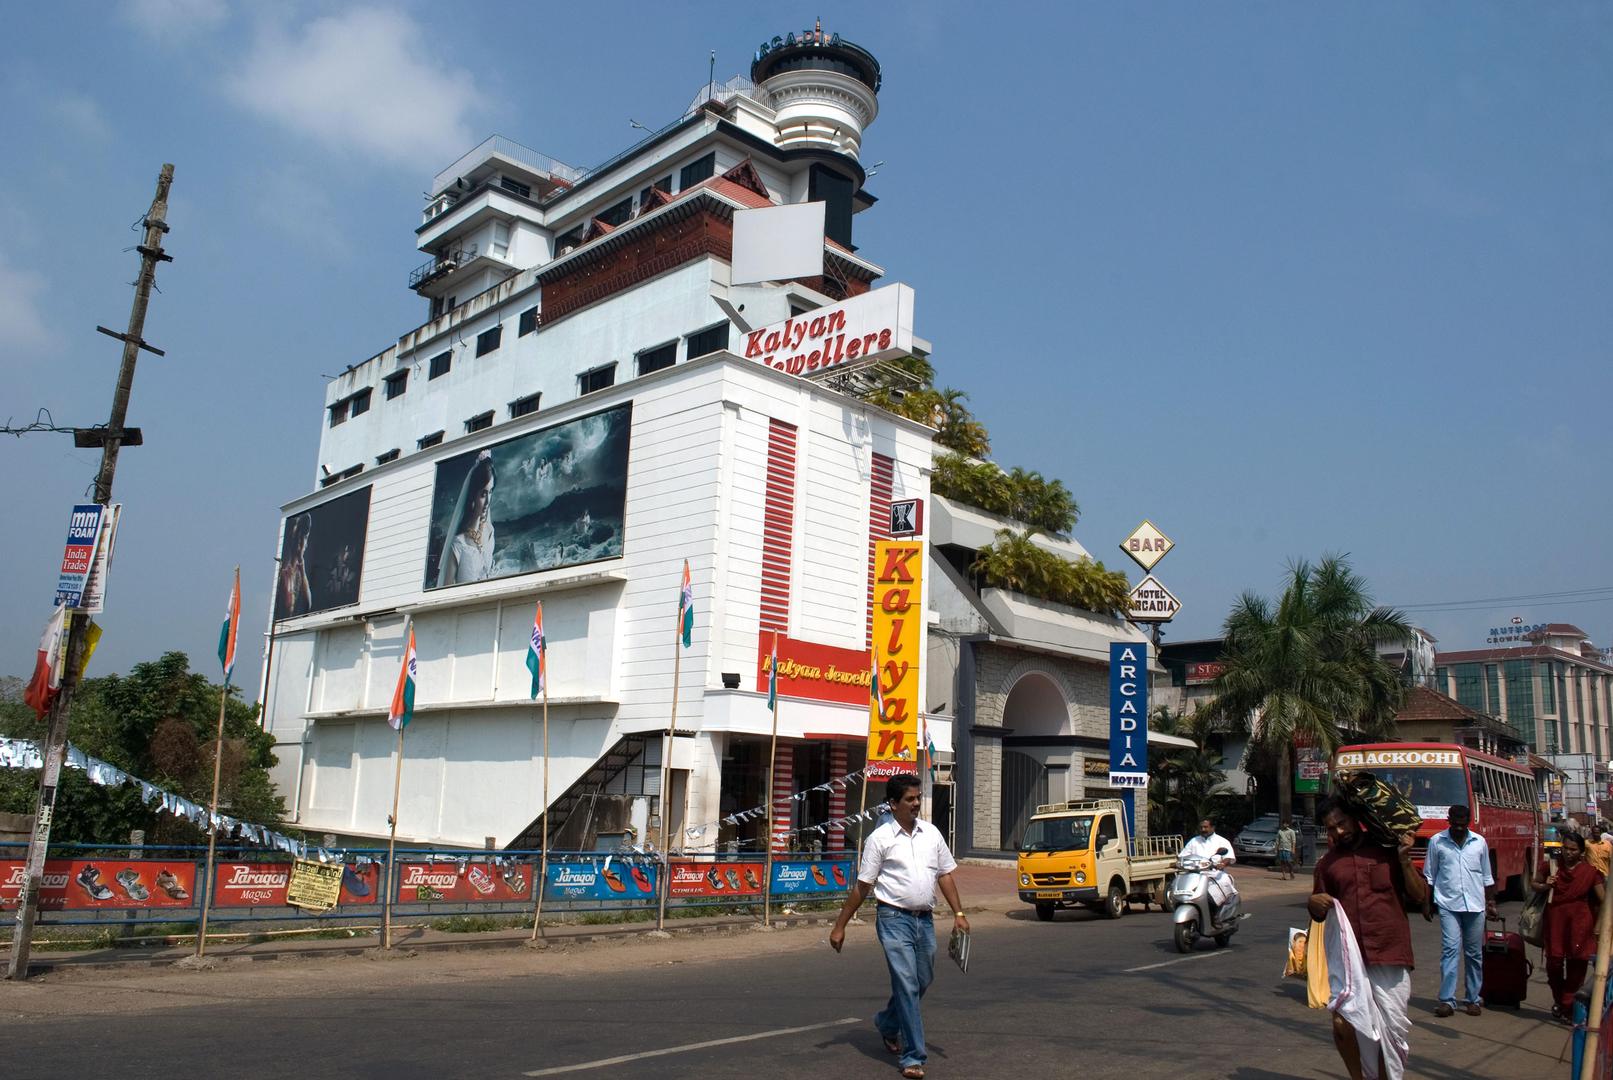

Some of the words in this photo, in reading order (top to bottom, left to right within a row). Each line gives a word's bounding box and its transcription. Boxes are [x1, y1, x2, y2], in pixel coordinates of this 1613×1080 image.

[744, 309, 847, 359] Kalyan
[71, 512, 98, 528] mm
[69, 527, 95, 538] FOAM
[1129, 537, 1166, 552] BAR
[67, 549, 87, 559] India
[63, 559, 88, 571] Trades
[1137, 590, 1166, 599] HOTEL
[1128, 600, 1175, 611] ARCADIA
[1486, 635, 1519, 643] CROWN
[877, 547, 919, 757] Kalyan
[1119, 647, 1137, 767] ARCADIA
[1337, 751, 1461, 766] CHACKOCHI
[1111, 775, 1146, 785] HOTEL
[4, 866, 70, 887] Pagon
[228, 865, 289, 887] Paragon
[404, 867, 458, 887] Paragon
[555, 867, 596, 885] Paragon
[673, 867, 705, 882] Paragon
[777, 865, 808, 880] Paragon
